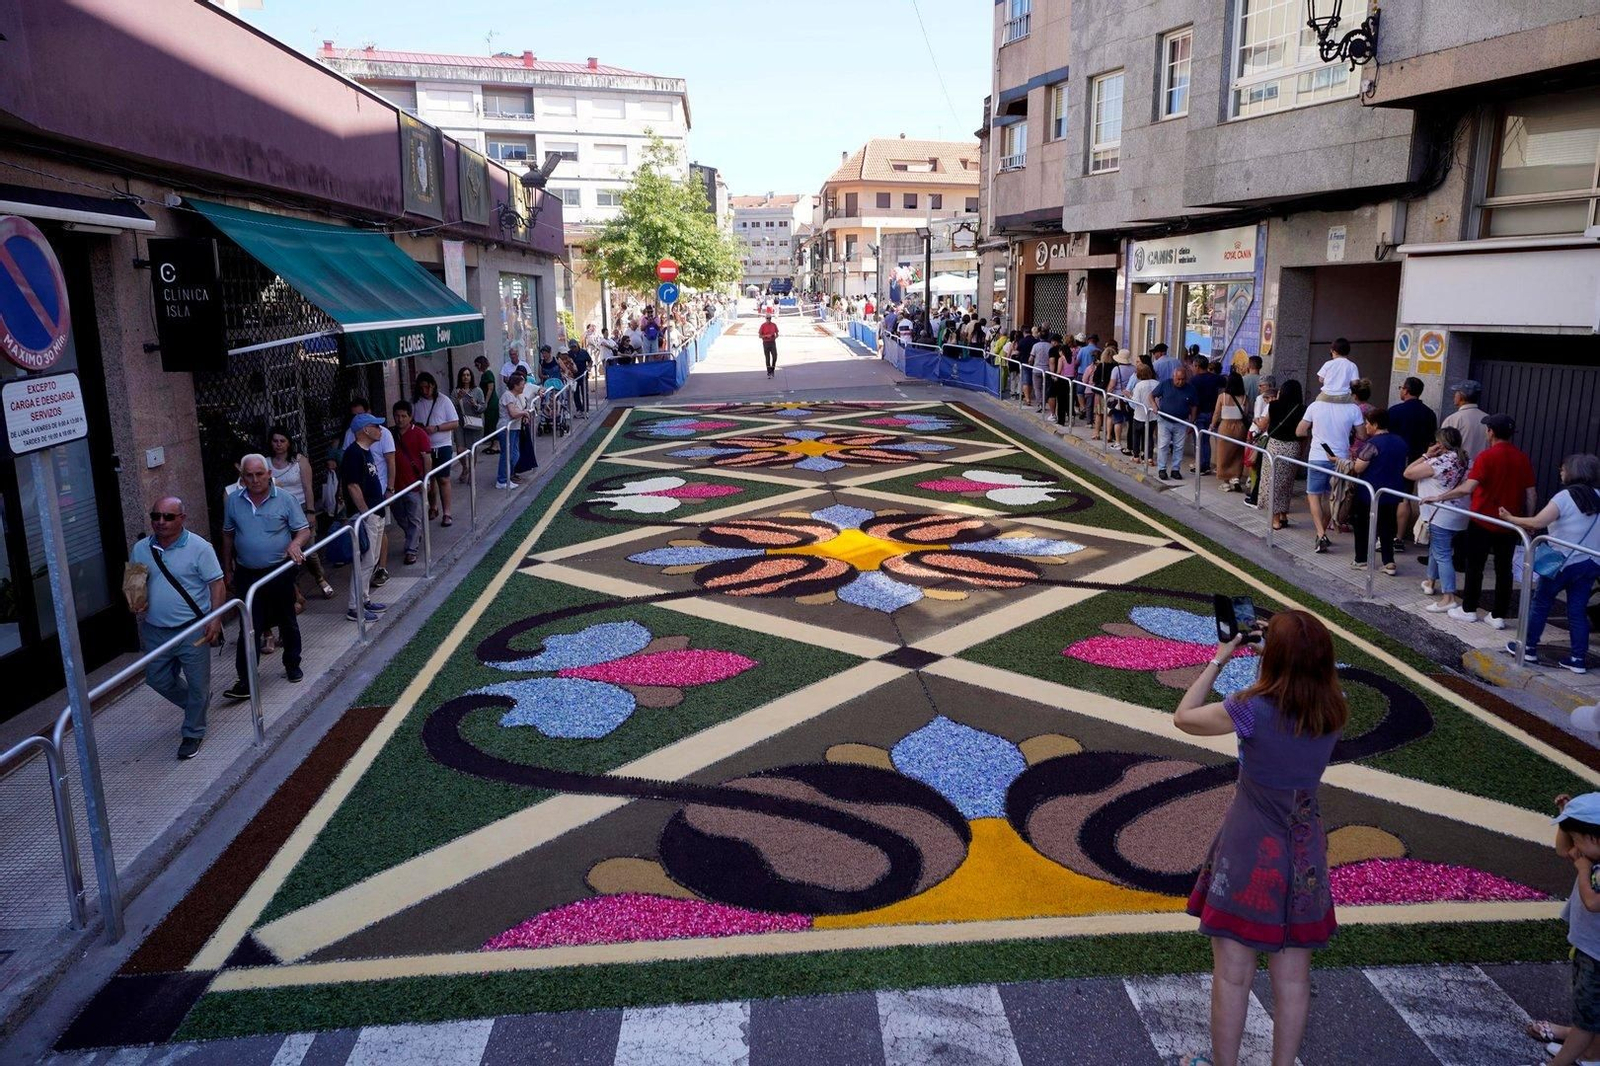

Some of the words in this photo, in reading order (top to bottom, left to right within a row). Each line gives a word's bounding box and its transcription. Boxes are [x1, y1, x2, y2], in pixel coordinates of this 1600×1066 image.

[1147, 249, 1174, 265] CANIS
[166, 304, 191, 318] ISLA
[3, 333, 43, 366] MAXIMO
[43, 349, 55, 364] 30
[399, 333, 425, 354] FLORES
[27, 381, 57, 394] EXCEPTO
[10, 399, 35, 411] CARGA
[35, 397, 41, 406] E
[41, 391, 76, 405] DESCARGA
[30, 407, 62, 421] SERVIZOS
[10, 431, 17, 439] DE
[18, 428, 30, 437] LUNS
[34, 424, 51, 433] VENRES
[23, 438, 41, 447] TARDES
